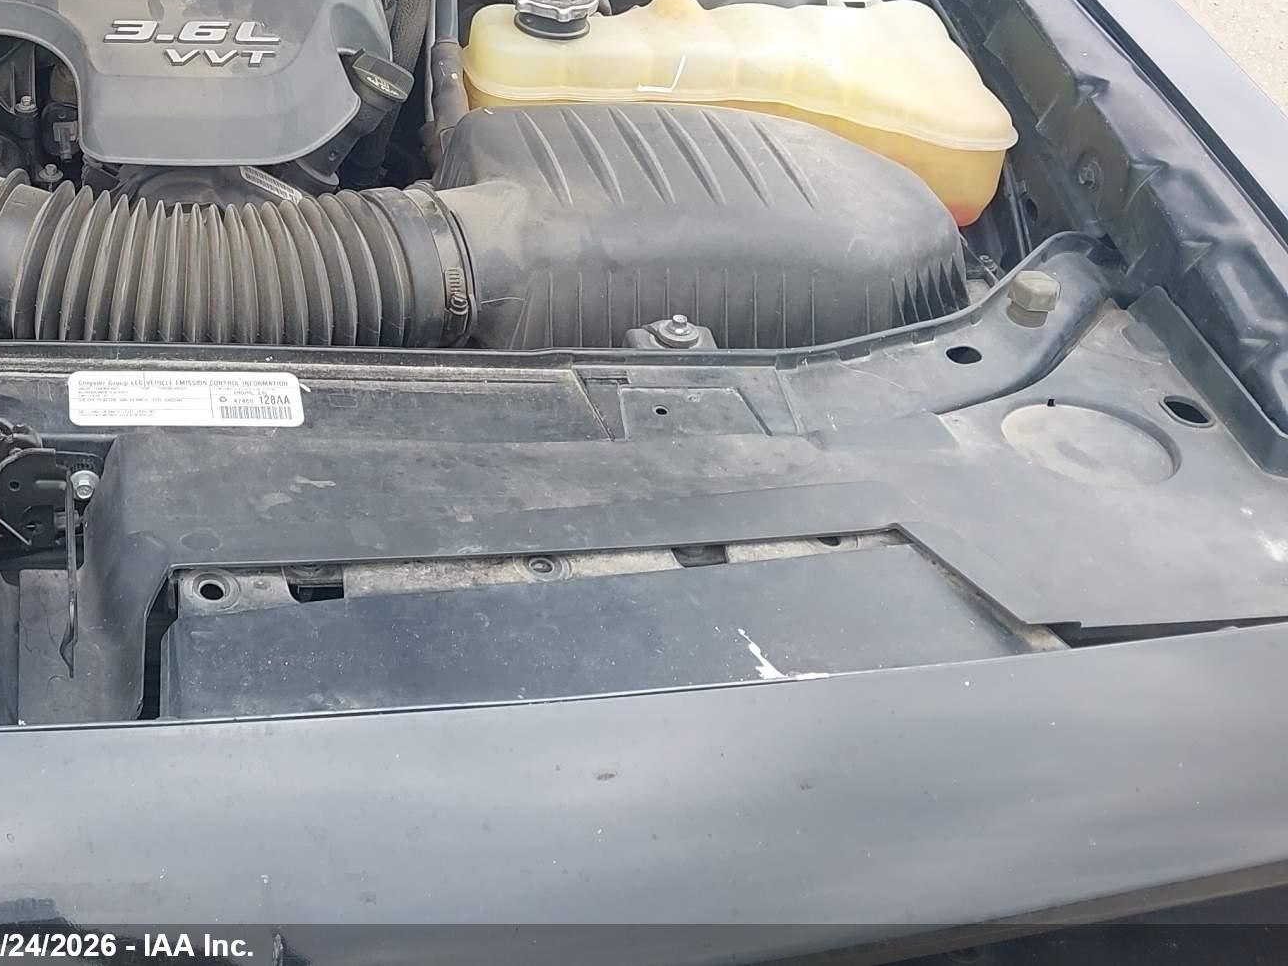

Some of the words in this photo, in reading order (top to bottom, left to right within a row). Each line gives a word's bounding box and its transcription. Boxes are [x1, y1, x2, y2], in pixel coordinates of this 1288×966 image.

[103, 20, 281, 45] 3.6L
[164, 49, 276, 67] VVT
[108, 379, 129, 387] Group
[259, 394, 291, 405] 128AA
